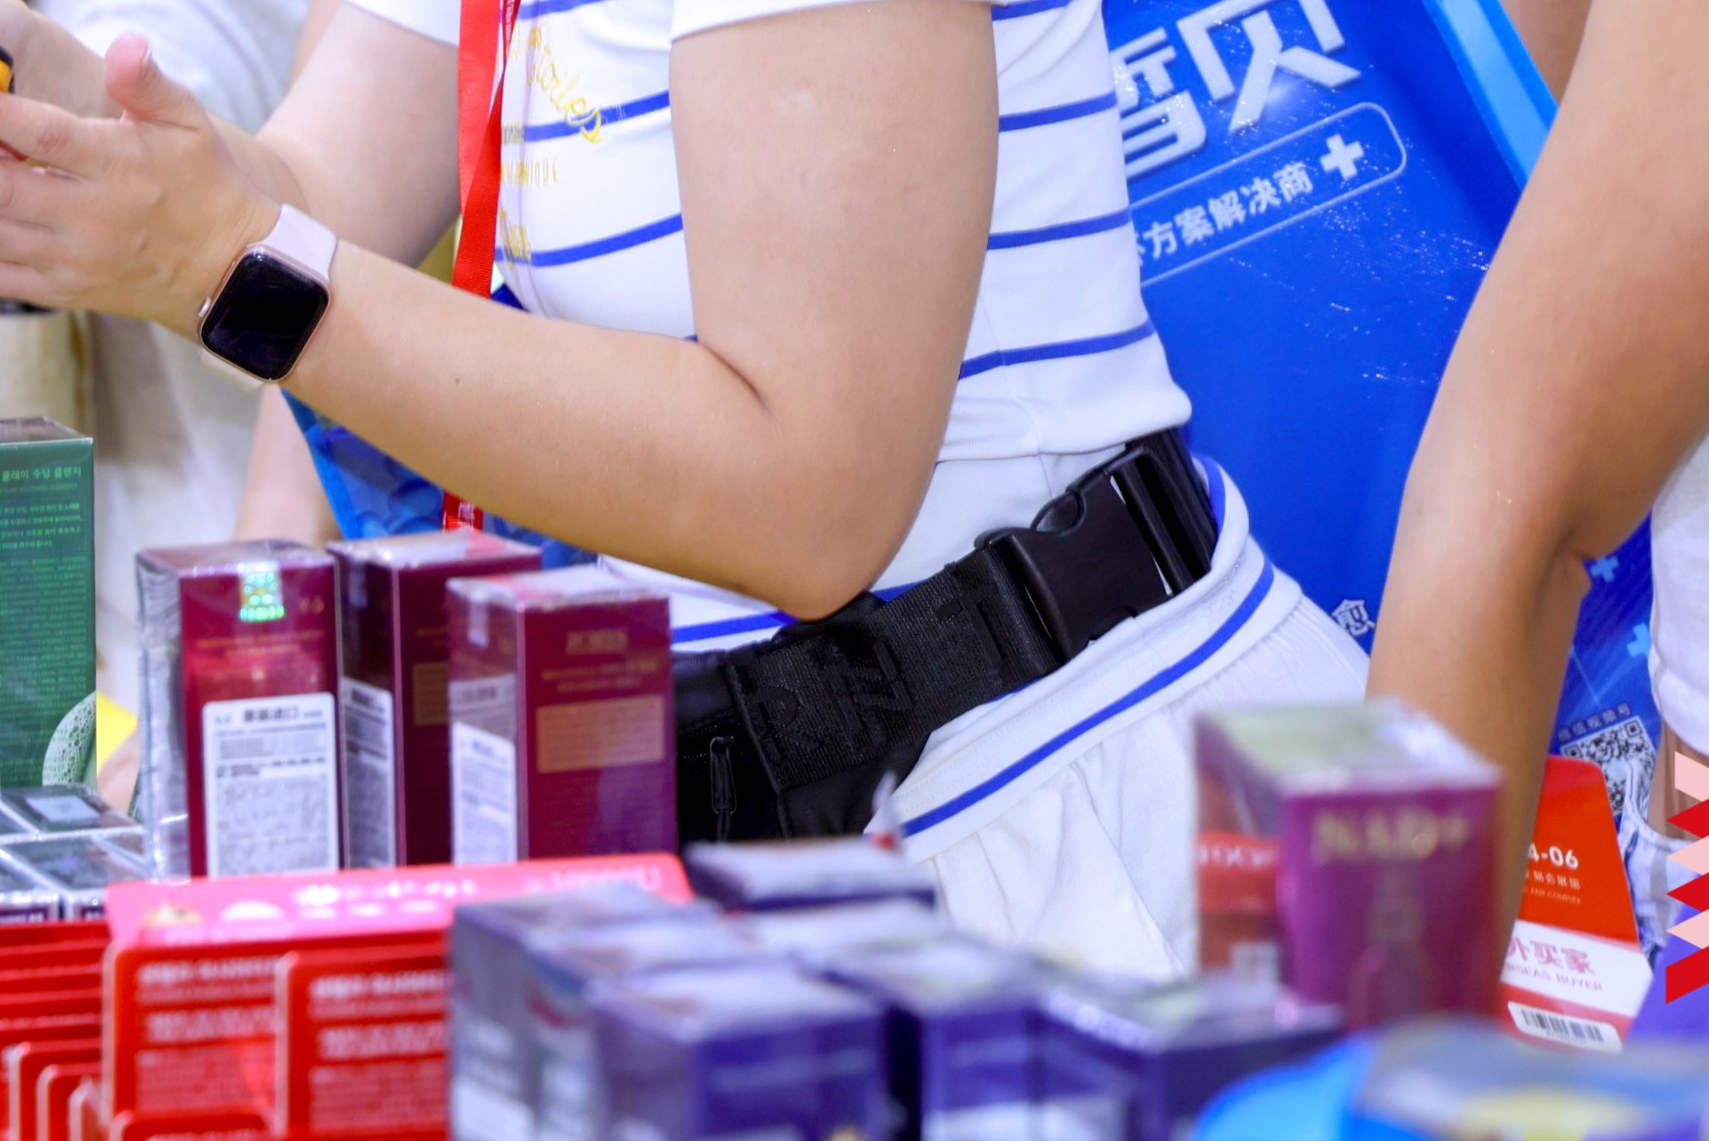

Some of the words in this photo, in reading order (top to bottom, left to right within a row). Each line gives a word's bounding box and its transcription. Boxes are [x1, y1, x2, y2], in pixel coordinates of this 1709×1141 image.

[1136, 160, 1315, 262] 方案解决商
